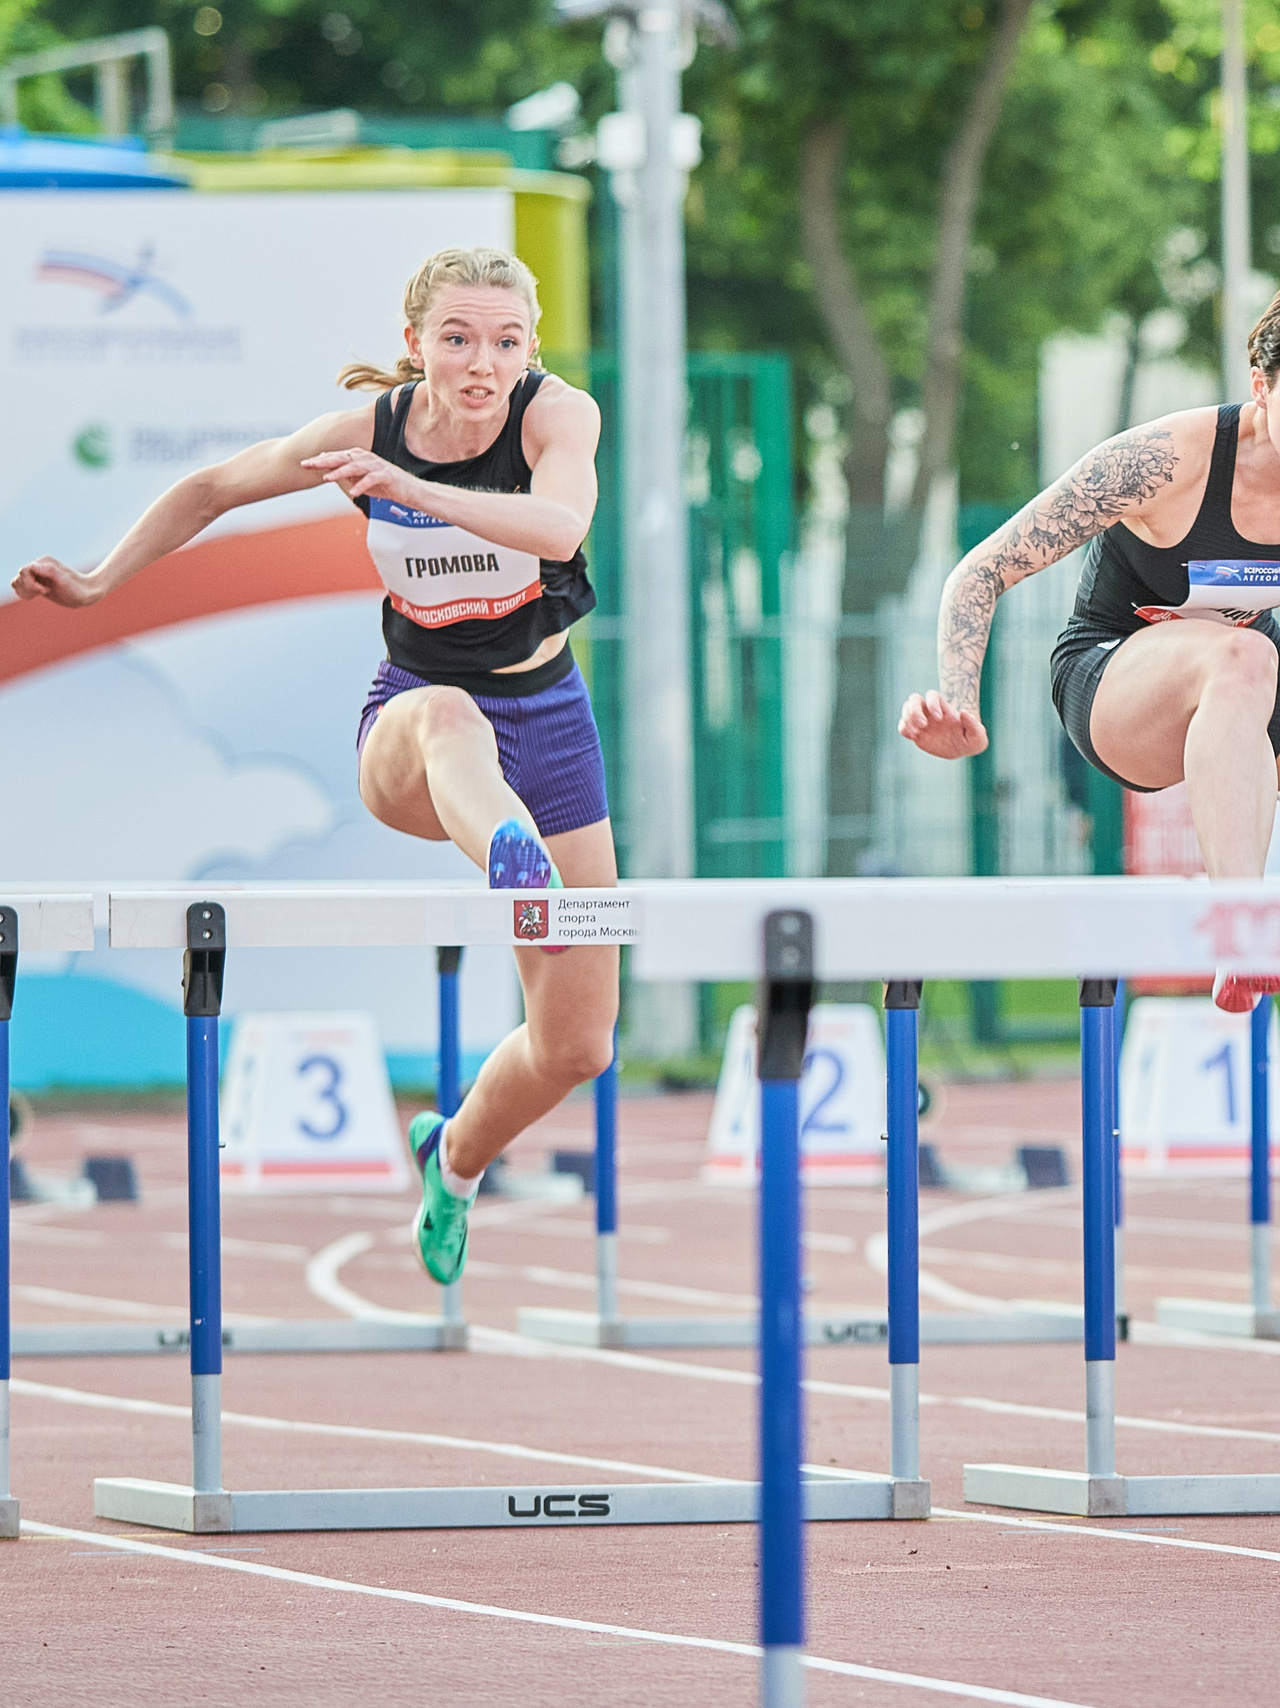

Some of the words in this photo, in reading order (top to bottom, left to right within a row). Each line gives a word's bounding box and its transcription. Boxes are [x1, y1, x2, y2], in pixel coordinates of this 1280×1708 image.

[404, 552, 500, 579] ГРОМОВА
[1243, 574, 1279, 582] ЛЕГКОЙ
[413, 599, 489, 624] МОСКОВСКИЙ
[493, 590, 527, 616] СПОРТ
[557, 899, 631, 910] Департамент
[558, 914, 597, 924] спорта
[558, 928, 597, 939] города
[801, 1047, 849, 1133] 2
[1202, 1041, 1237, 1126] 1
[298, 1056, 348, 1142] 3
[508, 1494, 611, 1517] UCS
